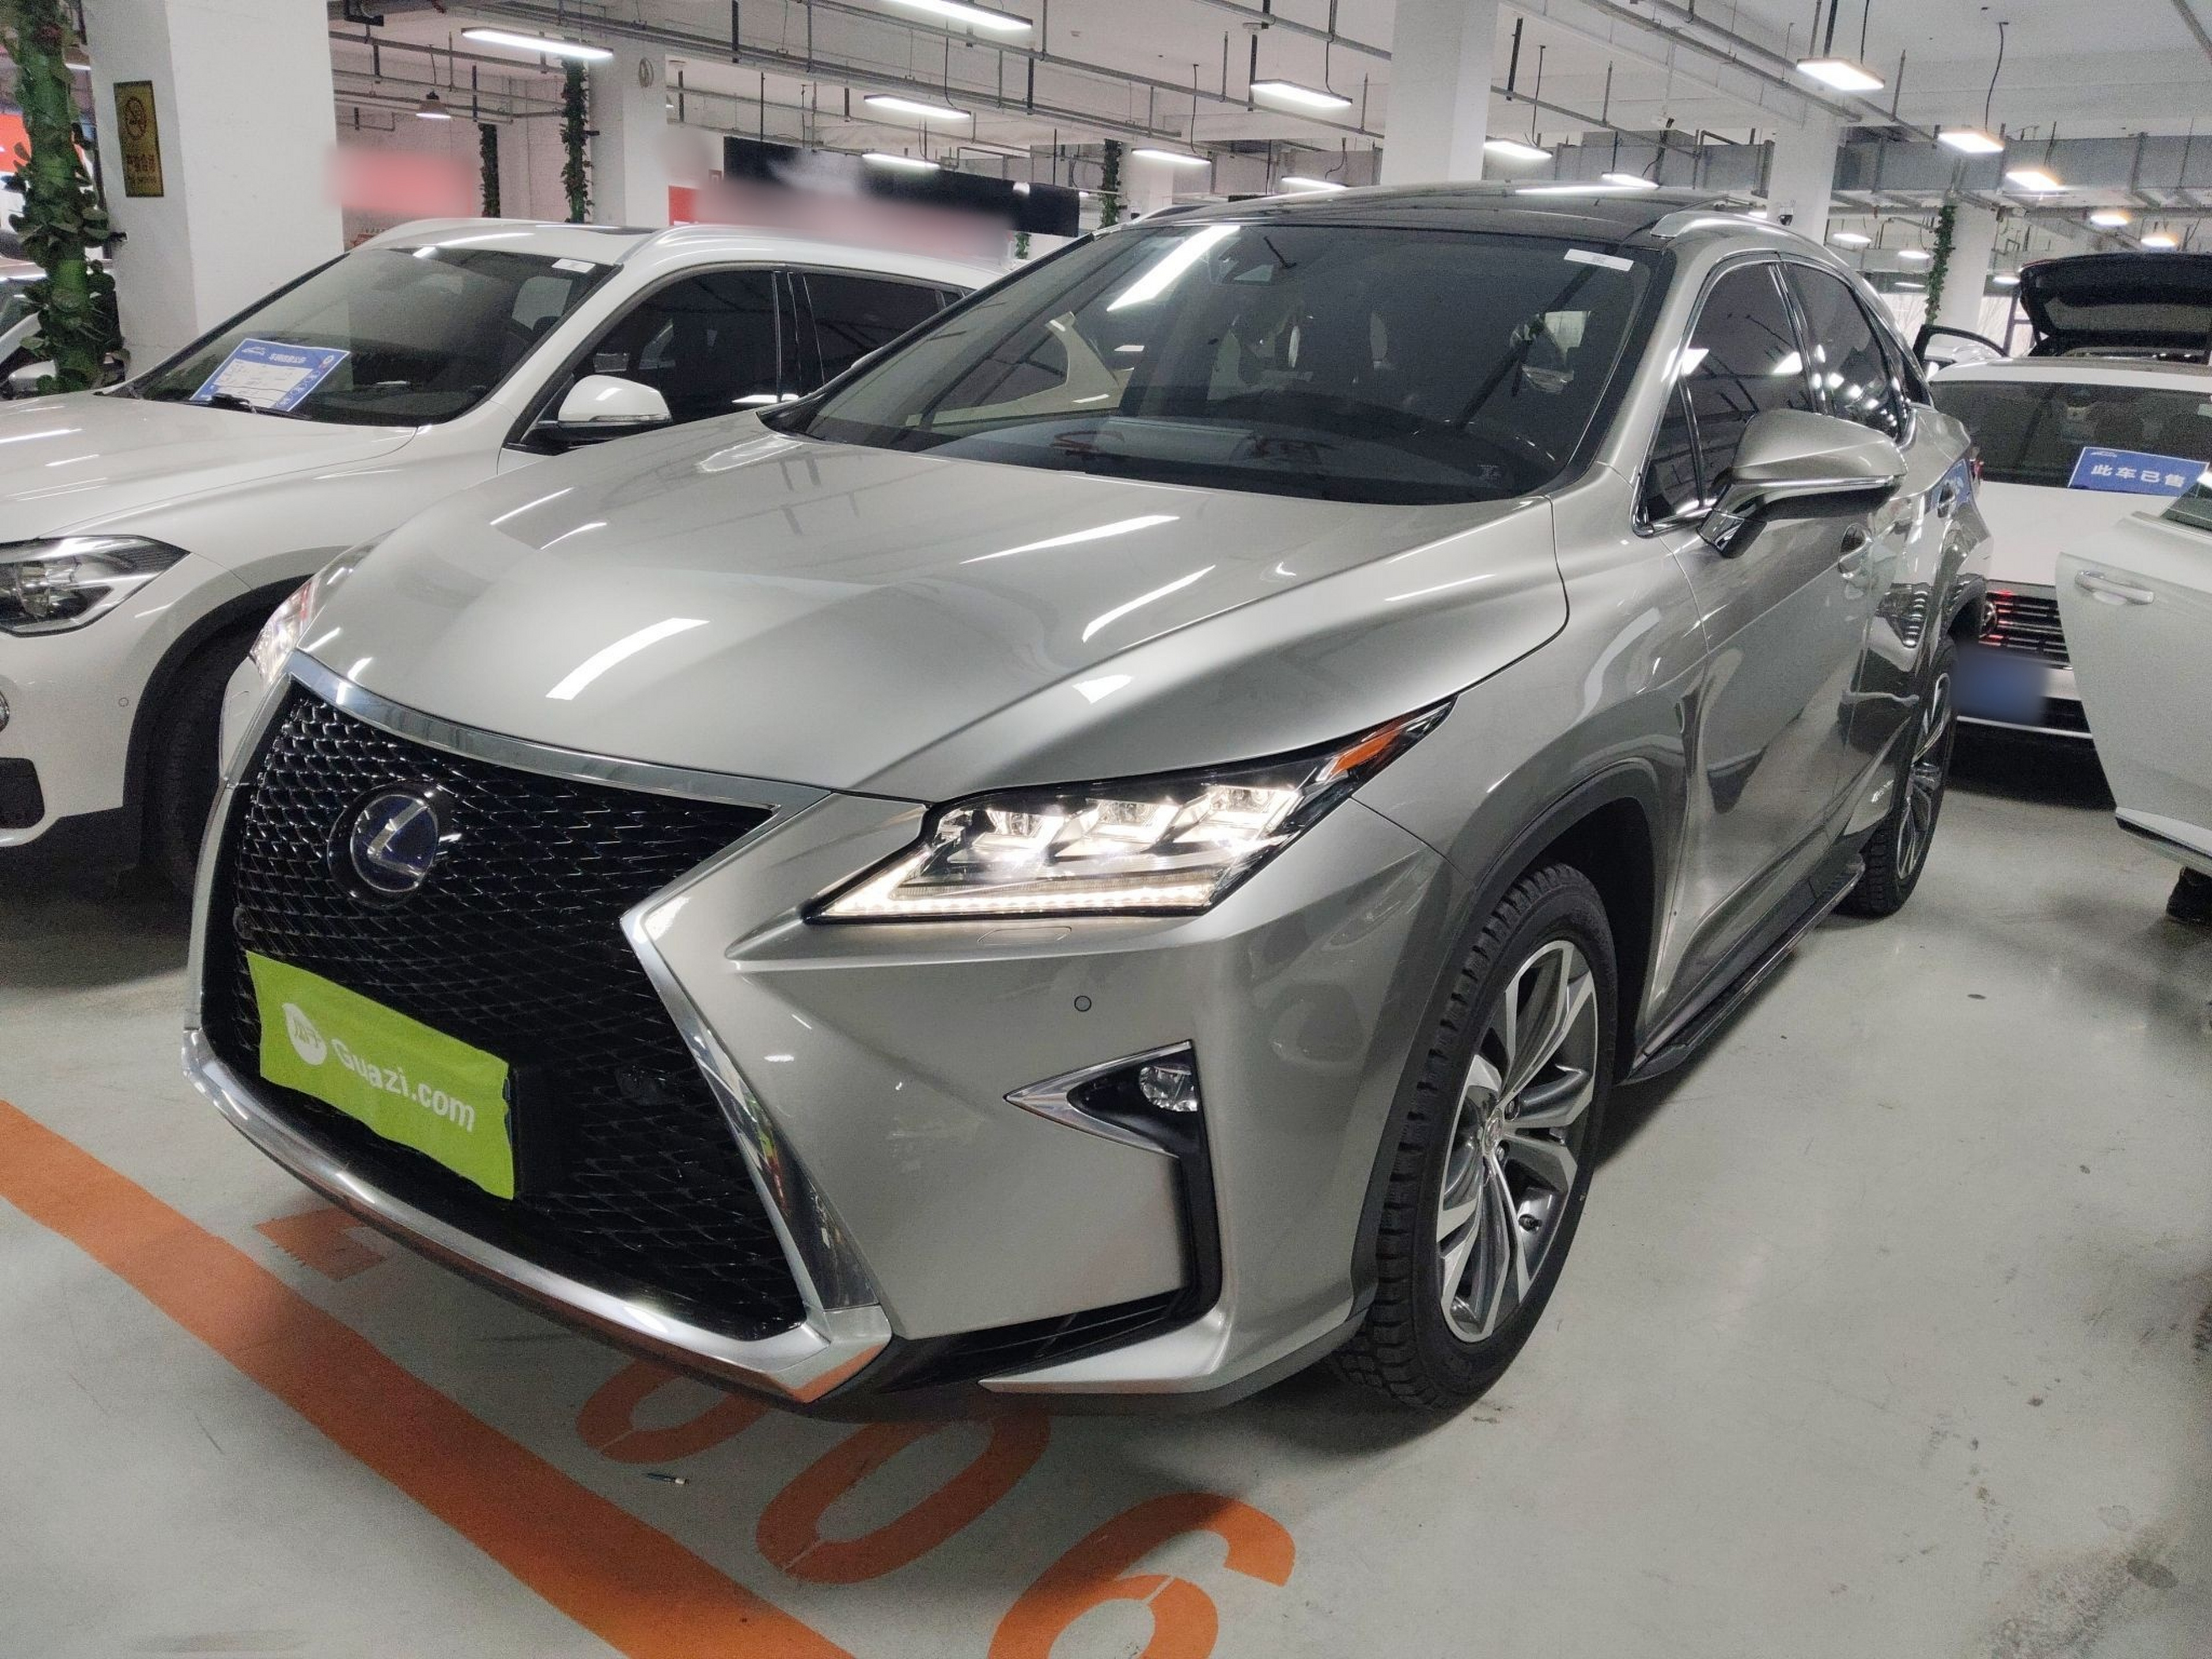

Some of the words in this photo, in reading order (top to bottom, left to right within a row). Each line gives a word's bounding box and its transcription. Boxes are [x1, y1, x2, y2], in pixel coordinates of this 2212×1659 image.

[2090, 464, 2186, 488] 此车已售
[331, 1038, 475, 1132] Guazi.com
